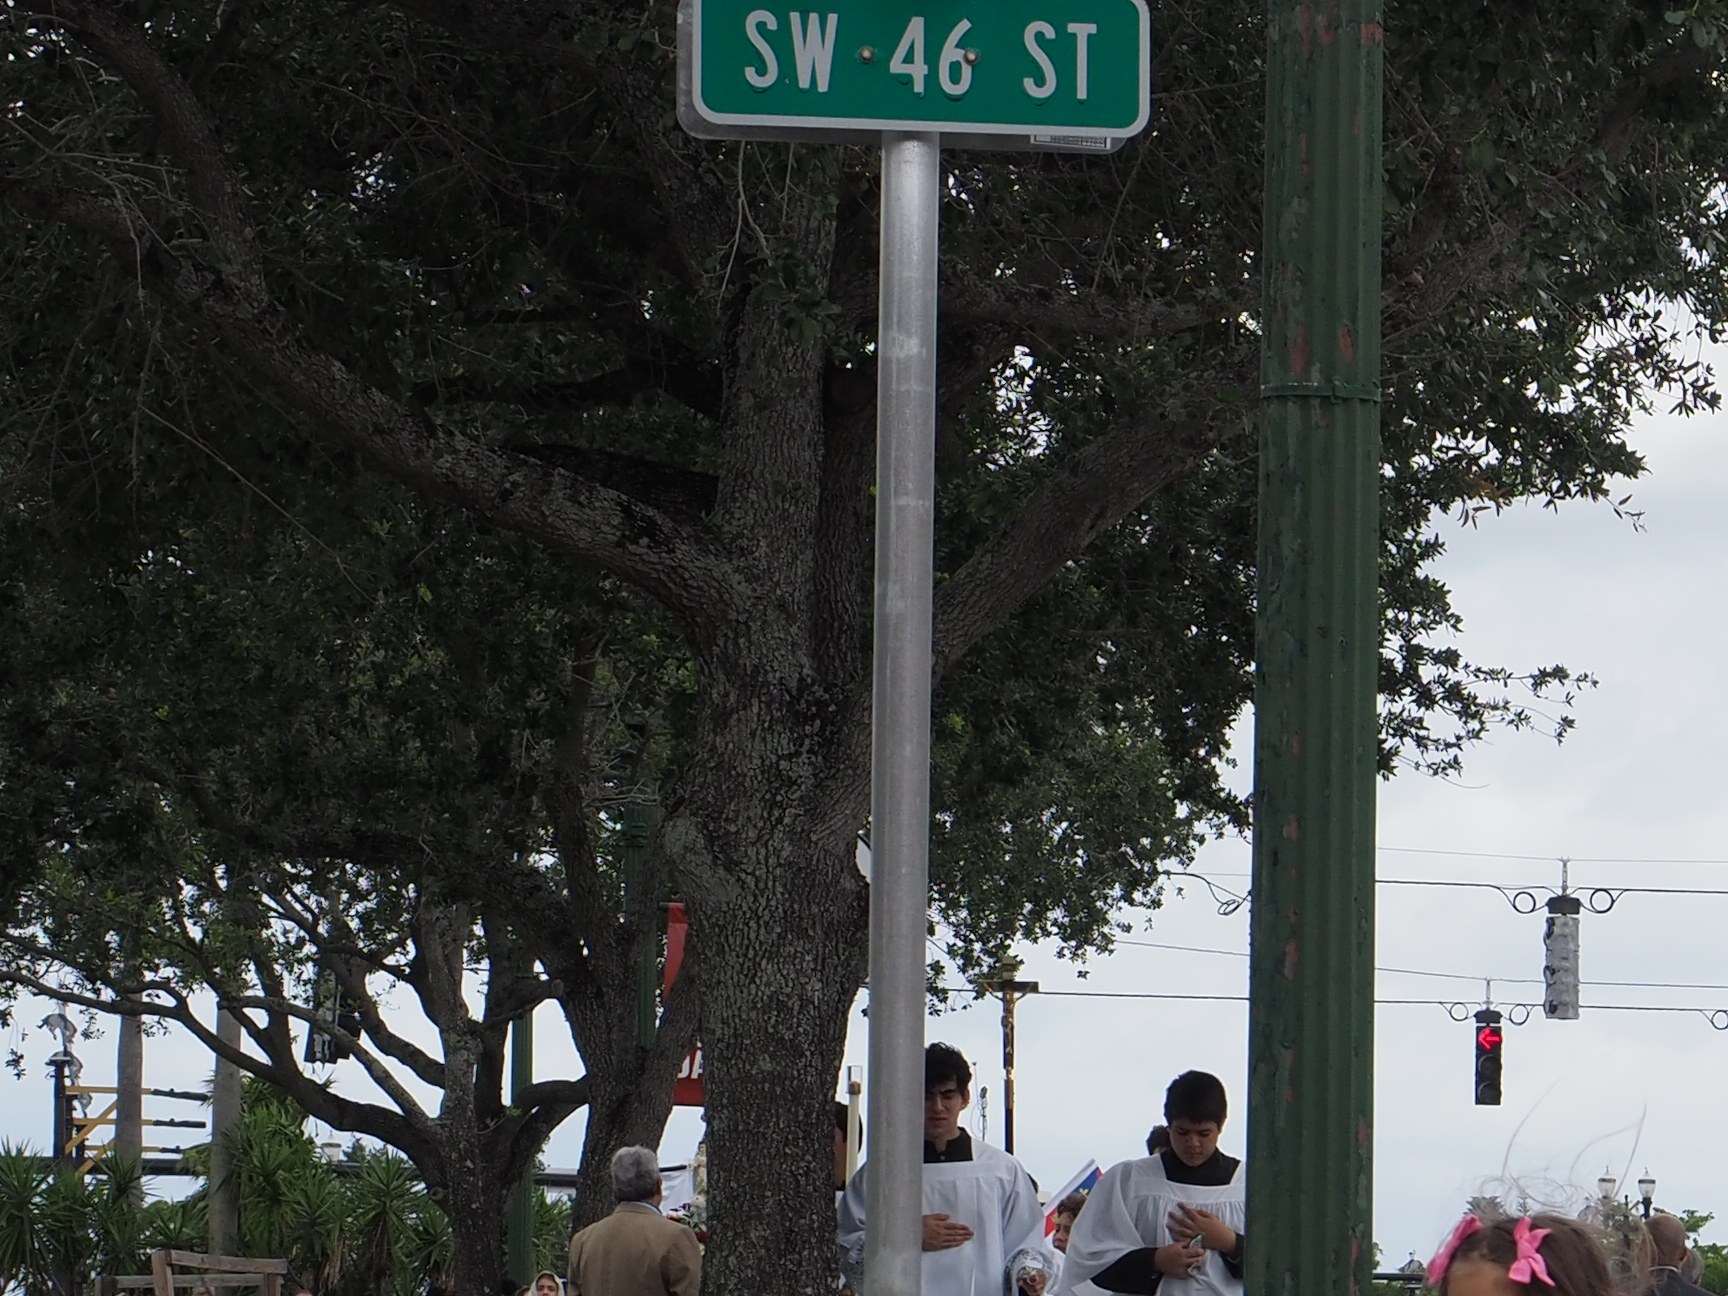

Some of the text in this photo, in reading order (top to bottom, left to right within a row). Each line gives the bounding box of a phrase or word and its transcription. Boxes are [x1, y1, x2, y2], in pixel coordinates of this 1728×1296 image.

[744, 9, 1098, 100] SW 46 ST
